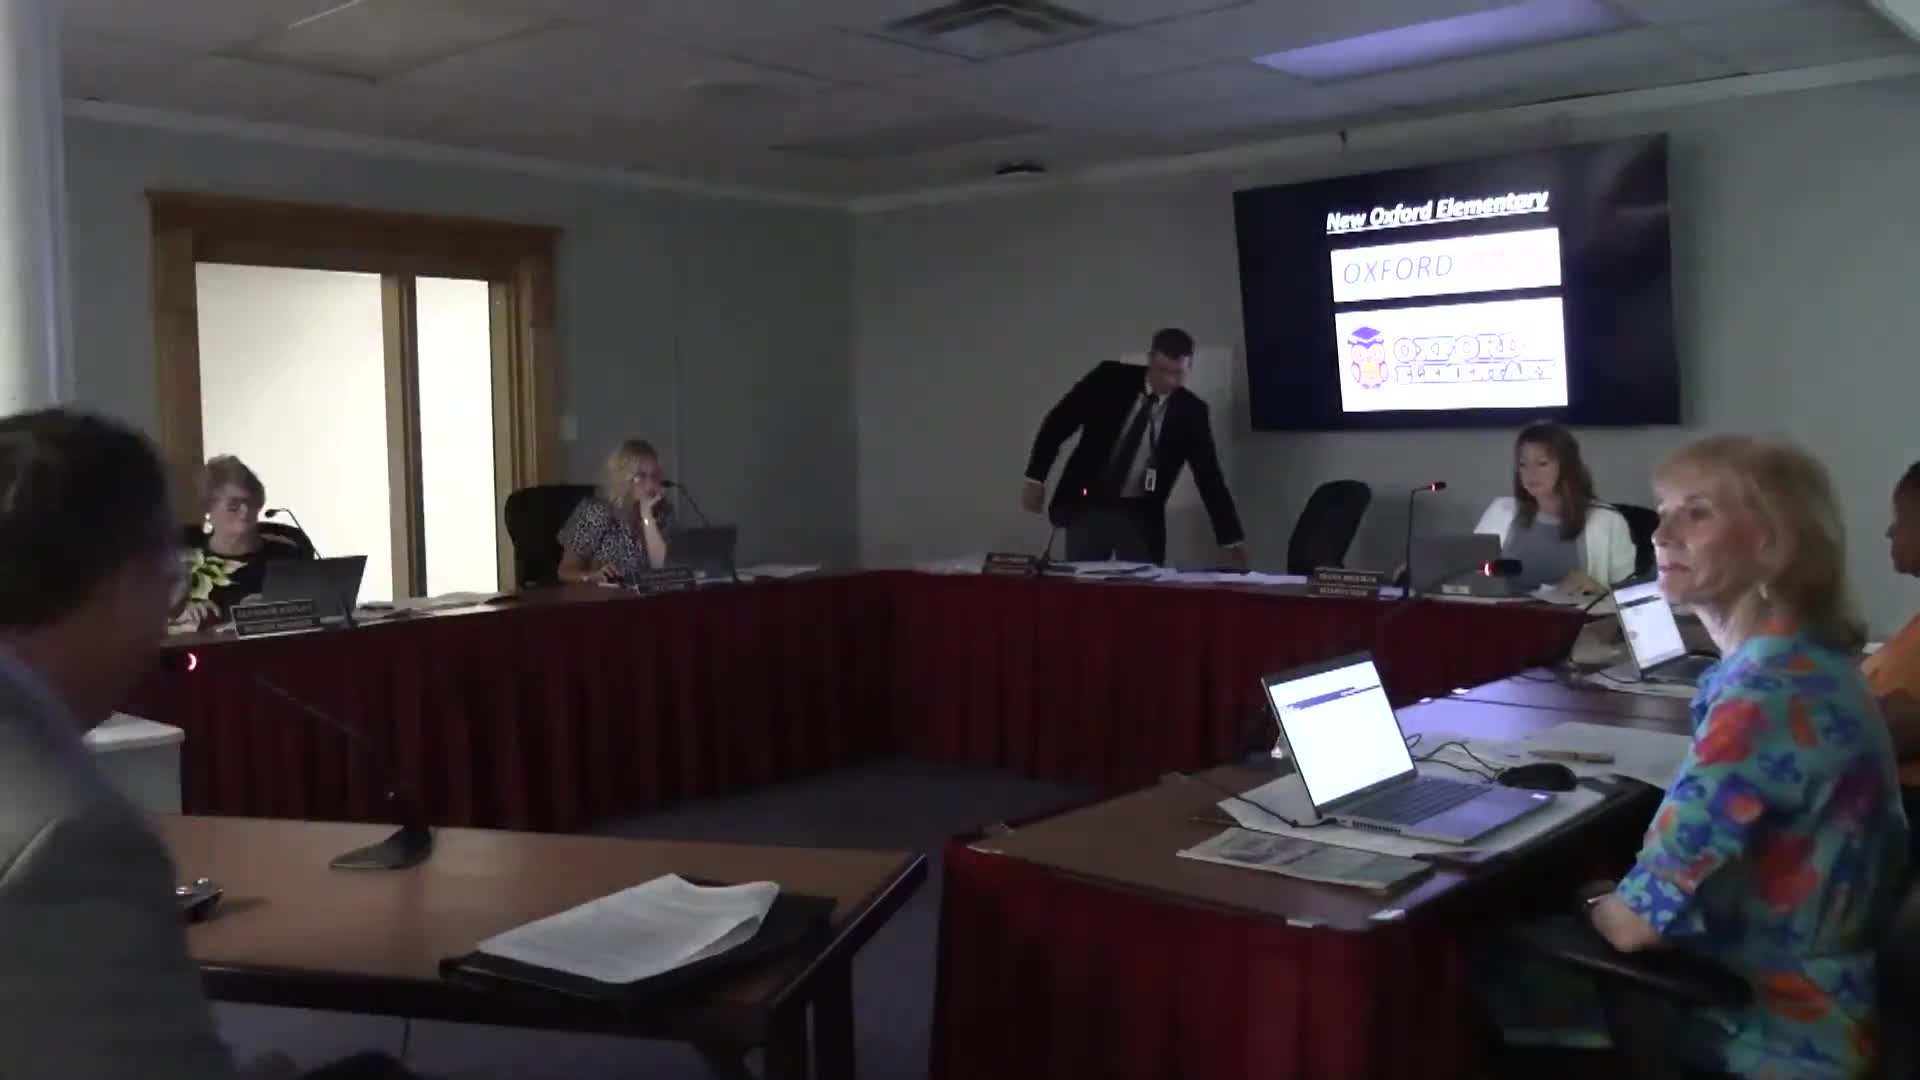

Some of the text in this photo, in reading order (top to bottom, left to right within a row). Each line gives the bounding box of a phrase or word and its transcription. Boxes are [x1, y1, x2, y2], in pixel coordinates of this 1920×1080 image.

[1326, 191, 1549, 232] New Oxford Elementary
[1343, 254, 1454, 285] OXFORD
